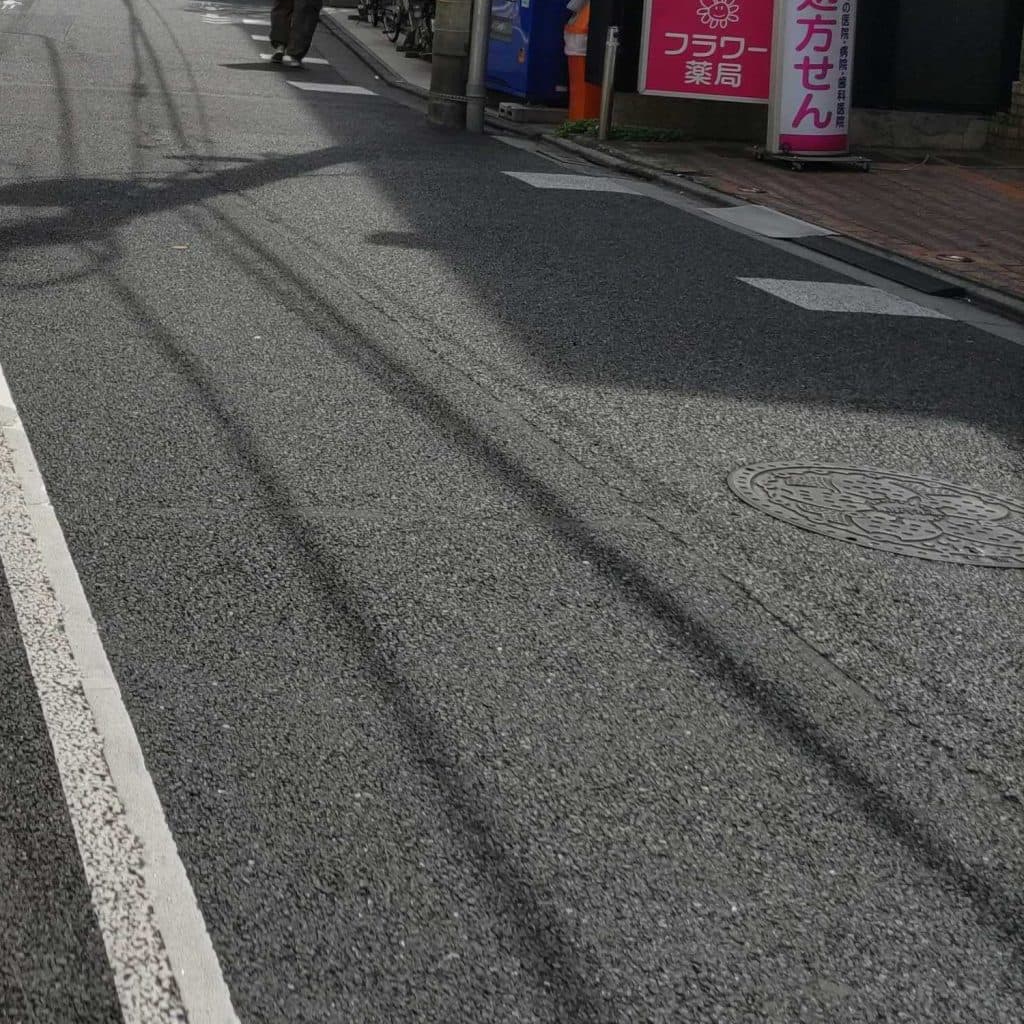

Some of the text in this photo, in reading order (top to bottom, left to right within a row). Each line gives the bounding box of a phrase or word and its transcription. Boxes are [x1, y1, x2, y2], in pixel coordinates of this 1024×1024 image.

[663, 34, 769, 59] フラワー
[684, 60, 743, 88] 薬局
